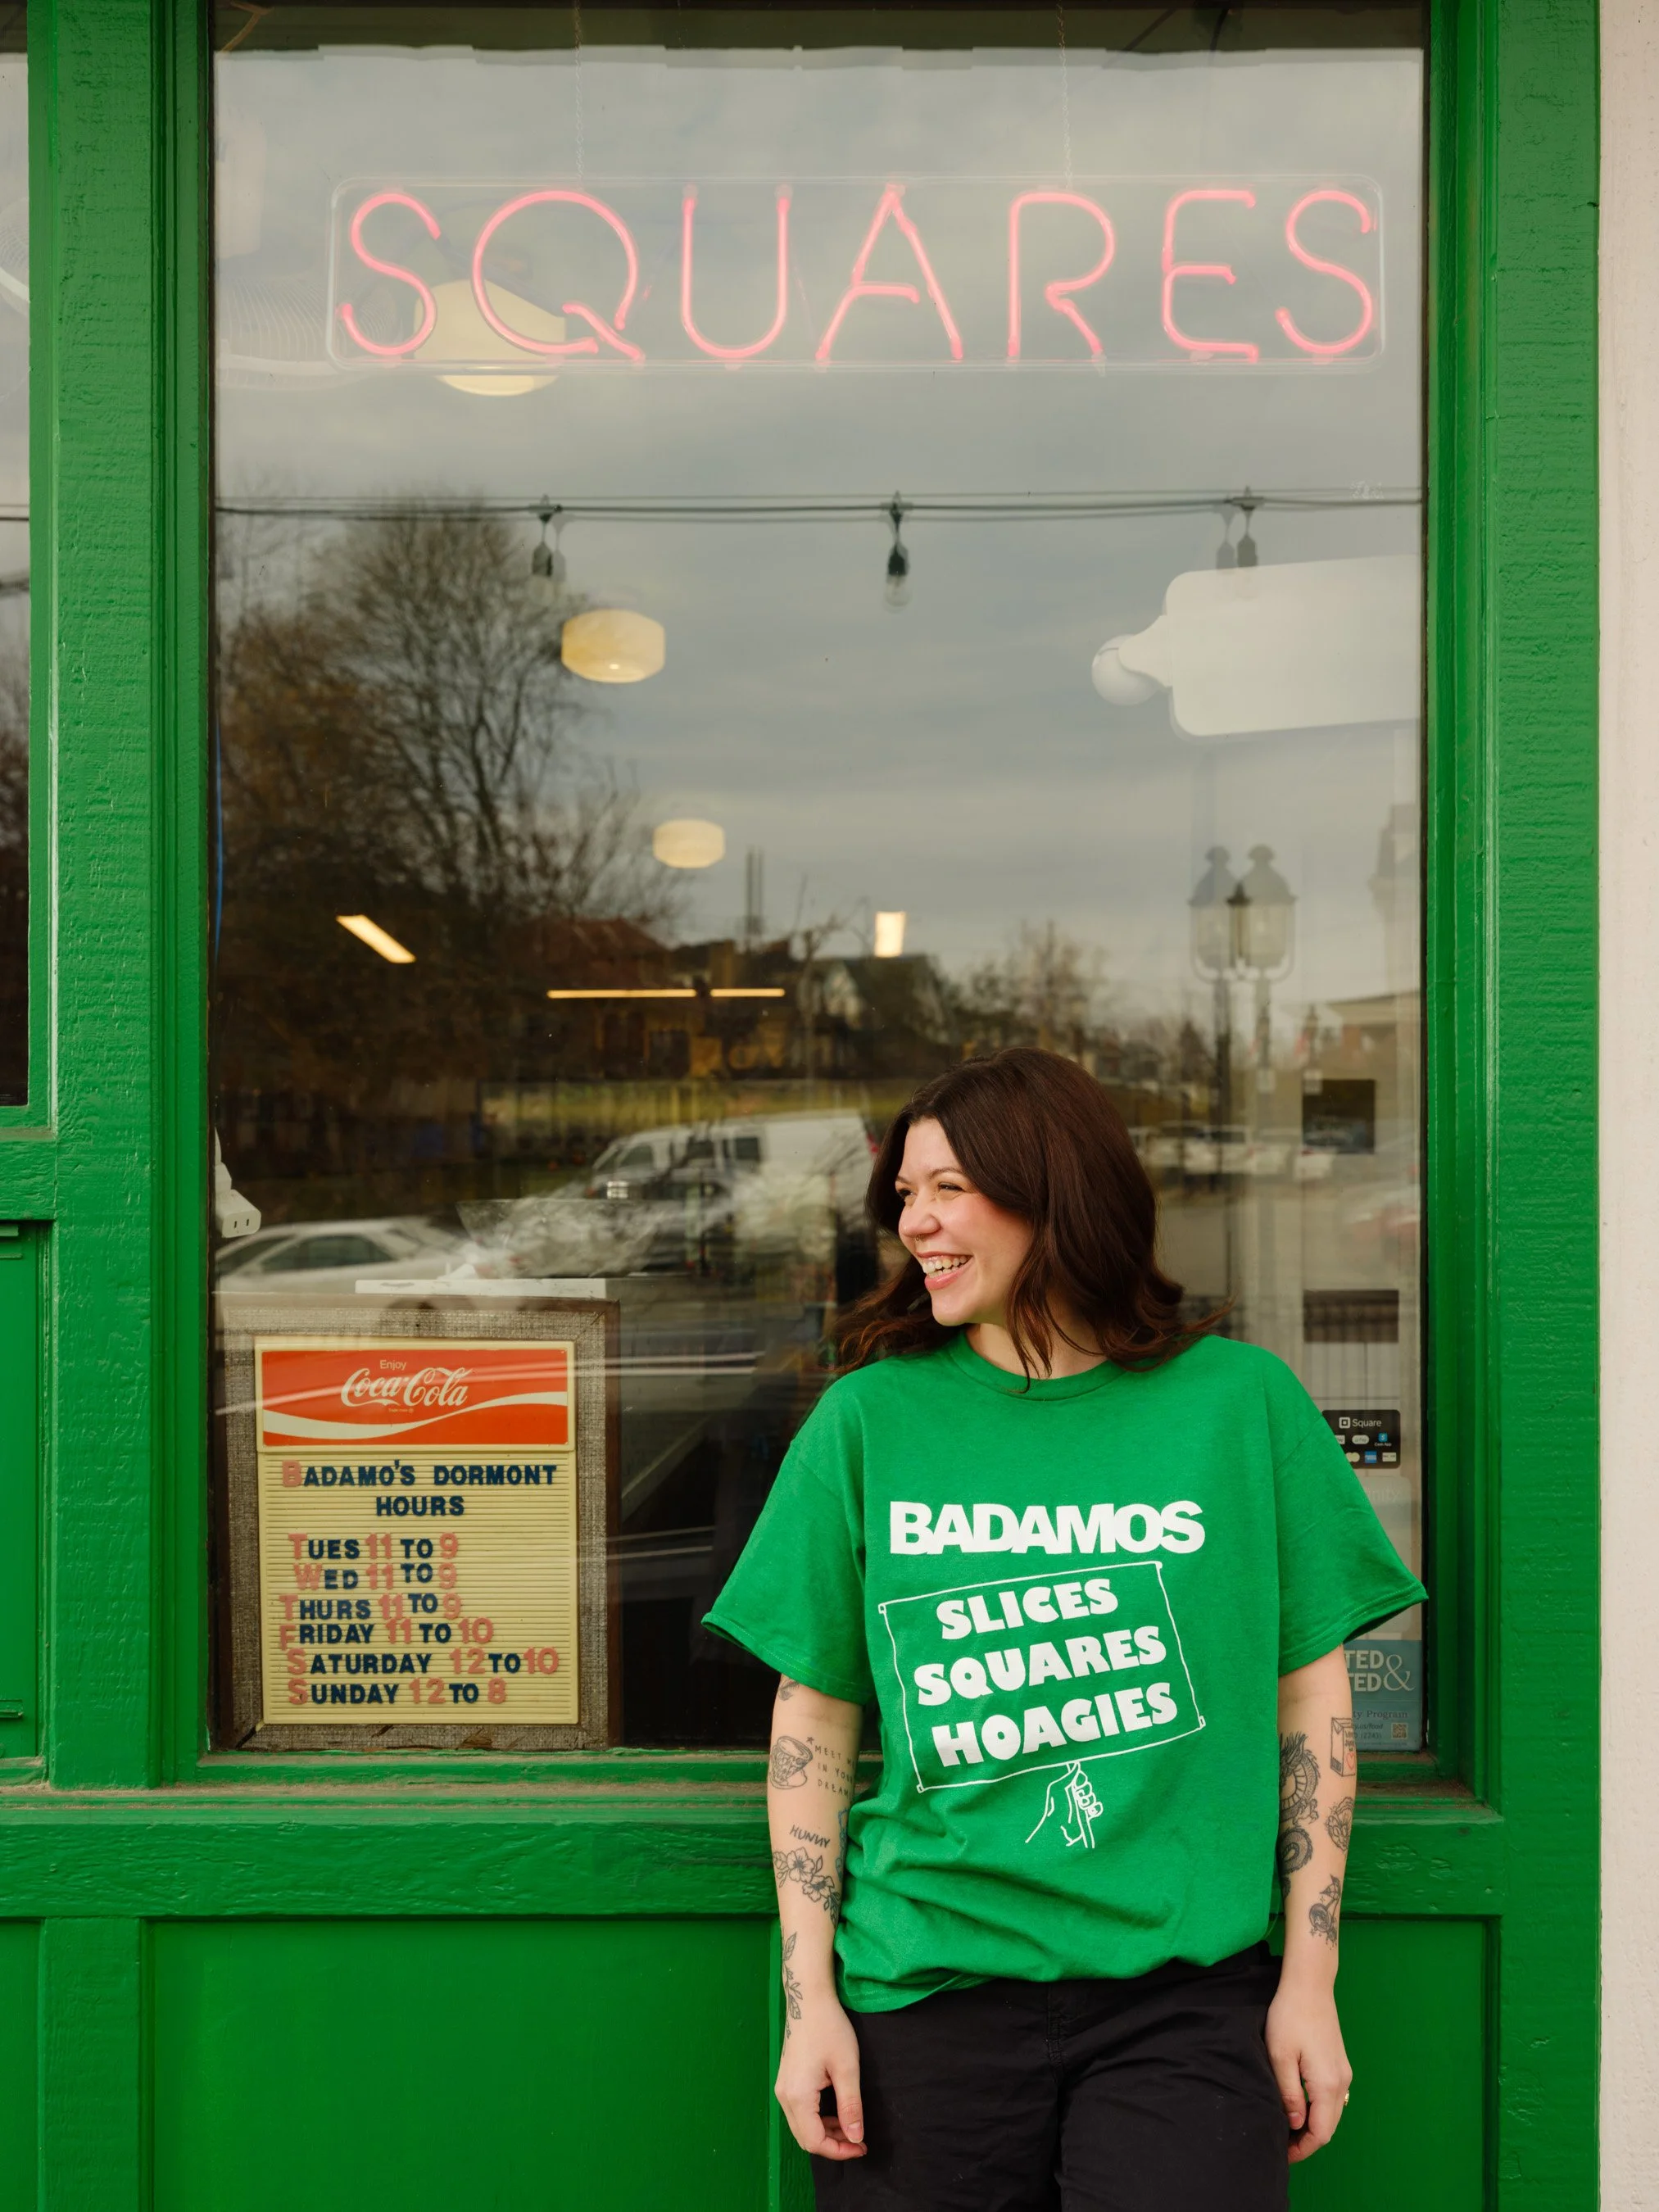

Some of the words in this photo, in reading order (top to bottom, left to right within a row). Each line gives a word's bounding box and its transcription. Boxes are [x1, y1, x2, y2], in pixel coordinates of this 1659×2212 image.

[334, 188, 1373, 363] SQUARES
[379, 1359, 407, 1371] Enjoy
[341, 1367, 474, 1407] Coca-Cola
[1352, 1419, 1382, 1428] Square
[282, 1459, 416, 1488] BADAMO'S
[433, 1465, 557, 1485] DORMONT
[376, 1496, 465, 1516] HOURS
[890, 1501, 1206, 1555] BADAMOS
[288, 1533, 360, 1560] TUES
[365, 1533, 392, 1560] 11
[401, 1539, 433, 1559] TO
[439, 1533, 459, 1560] 9
[293, 1563, 359, 1590] WED
[365, 1563, 393, 1590] 11
[401, 1563, 433, 1584] TO
[438, 1562, 458, 1590] 9
[279, 1594, 371, 1620] THURS
[378, 1593, 405, 1620] 11
[408, 1593, 438, 1614] TO
[442, 1593, 462, 1620] 9
[936, 1579, 1118, 1640] SLICES
[279, 1623, 374, 1651] FRIDAY
[385, 1618, 412, 1644] 11
[419, 1623, 452, 1643] TO
[458, 1617, 494, 1644] 10
[287, 1648, 433, 1675] SATURDAY
[449, 1648, 487, 1675] 12
[488, 1653, 521, 1674] TO
[523, 1647, 560, 1675] 10
[913, 1625, 1167, 1707] SQUARES
[1384, 1654, 1416, 1692] &
[288, 1678, 399, 1706] SUNDAY
[410, 1677, 446, 1704] 12
[449, 1684, 479, 1704] TO
[487, 1677, 507, 1705] 8
[931, 1682, 1178, 1768] HOAGIES
[1367, 1711, 1408, 1720] Program
[814, 1745, 842, 1760] MEET
[818, 1762, 827, 1772] IN
